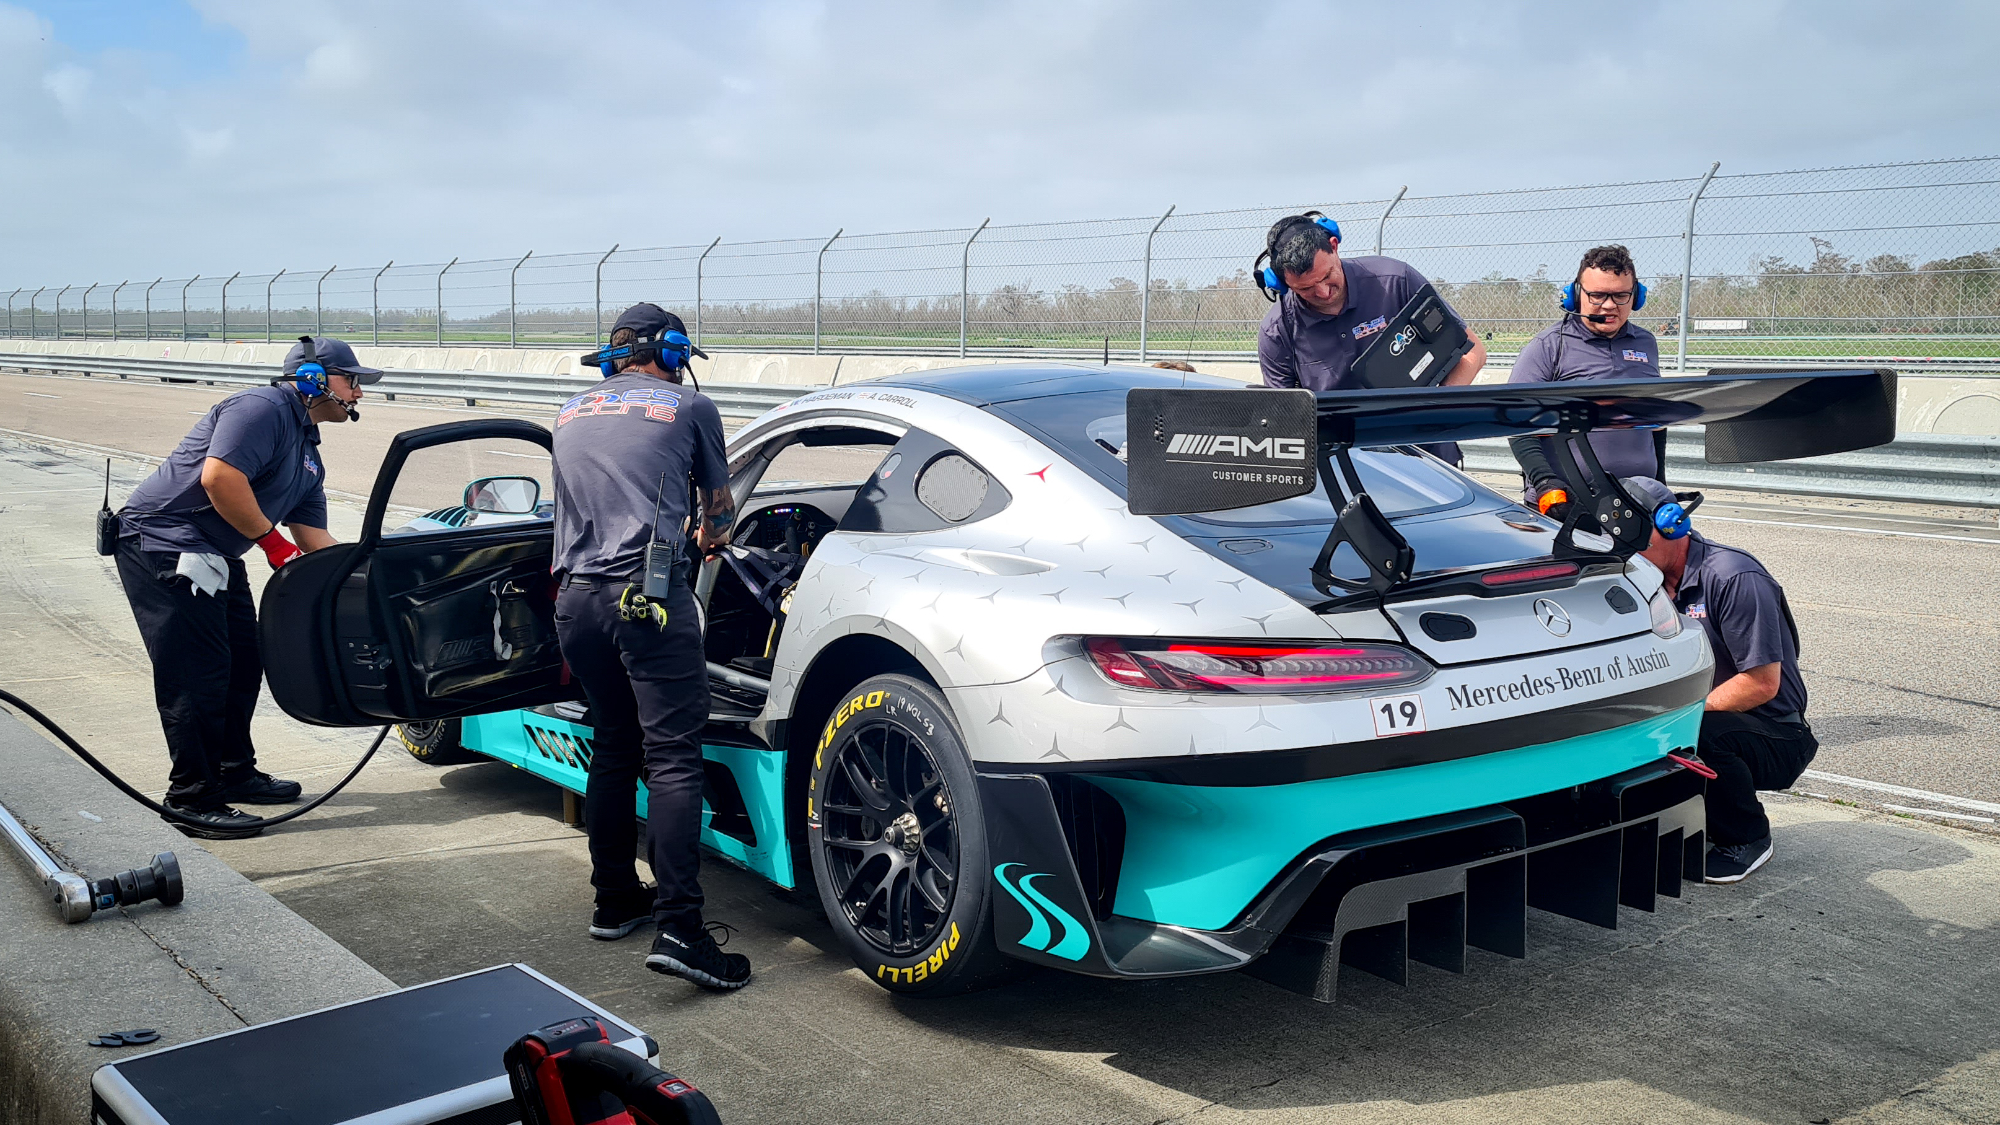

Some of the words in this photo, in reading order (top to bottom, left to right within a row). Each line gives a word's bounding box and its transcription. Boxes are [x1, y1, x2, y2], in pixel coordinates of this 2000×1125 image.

[878, 393, 918, 408] CARROLL
[1207, 435, 1305, 460] AMG
[1212, 470, 1263, 483] CUSTOMER
[1265, 474, 1304, 485] SPORTS
[1444, 666, 1606, 711] Mercedes-Benz
[1607, 655, 1622, 679] of
[1626, 647, 1671, 677] Austin
[885, 704, 898, 717] LR
[897, 695, 906, 710] 19
[1379, 700, 1418, 728] 19
[877, 921, 961, 984] PIRELLI
